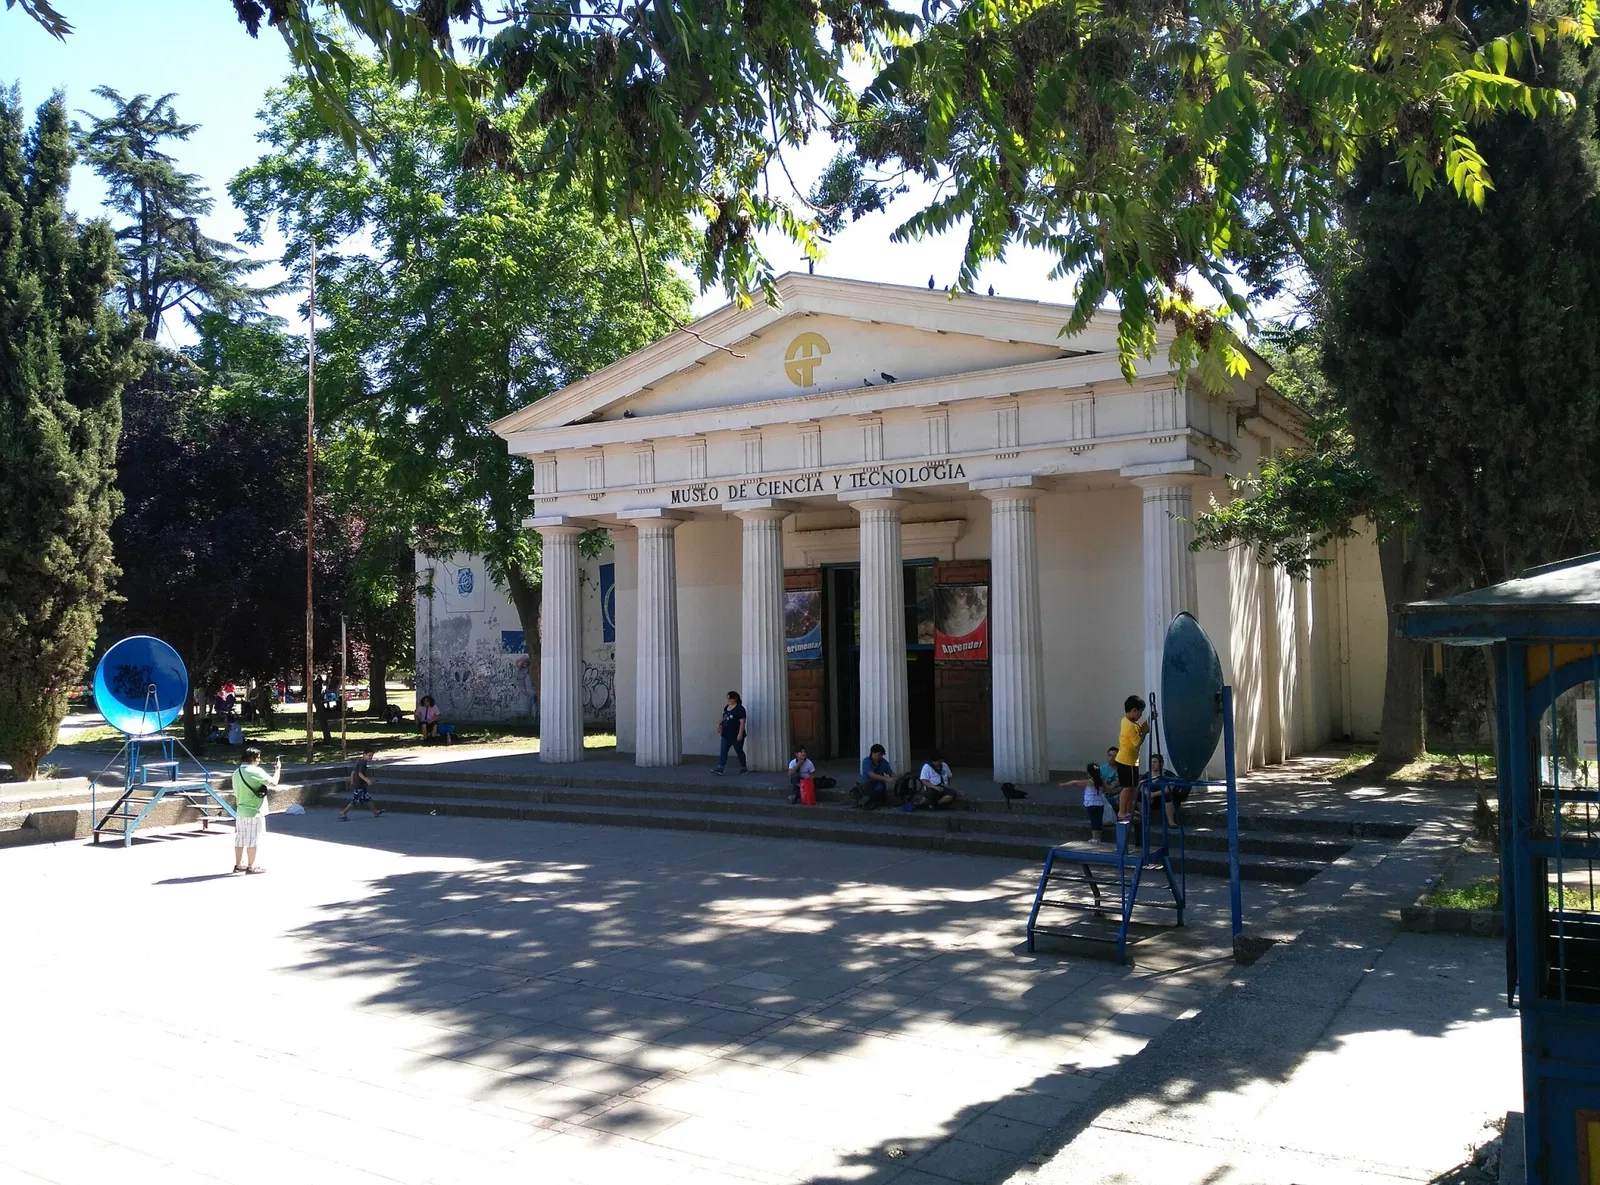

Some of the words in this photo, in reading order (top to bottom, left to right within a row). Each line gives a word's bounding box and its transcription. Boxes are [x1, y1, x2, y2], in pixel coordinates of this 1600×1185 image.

[670, 486, 719, 505] MUSEO
[728, 483, 748, 499] DE
[756, 475, 824, 497] CIENCIA
[832, 474, 843, 490] Y
[849, 463, 966, 488] TECNOLOGIA
[941, 640, 983, 654] Aprende!
